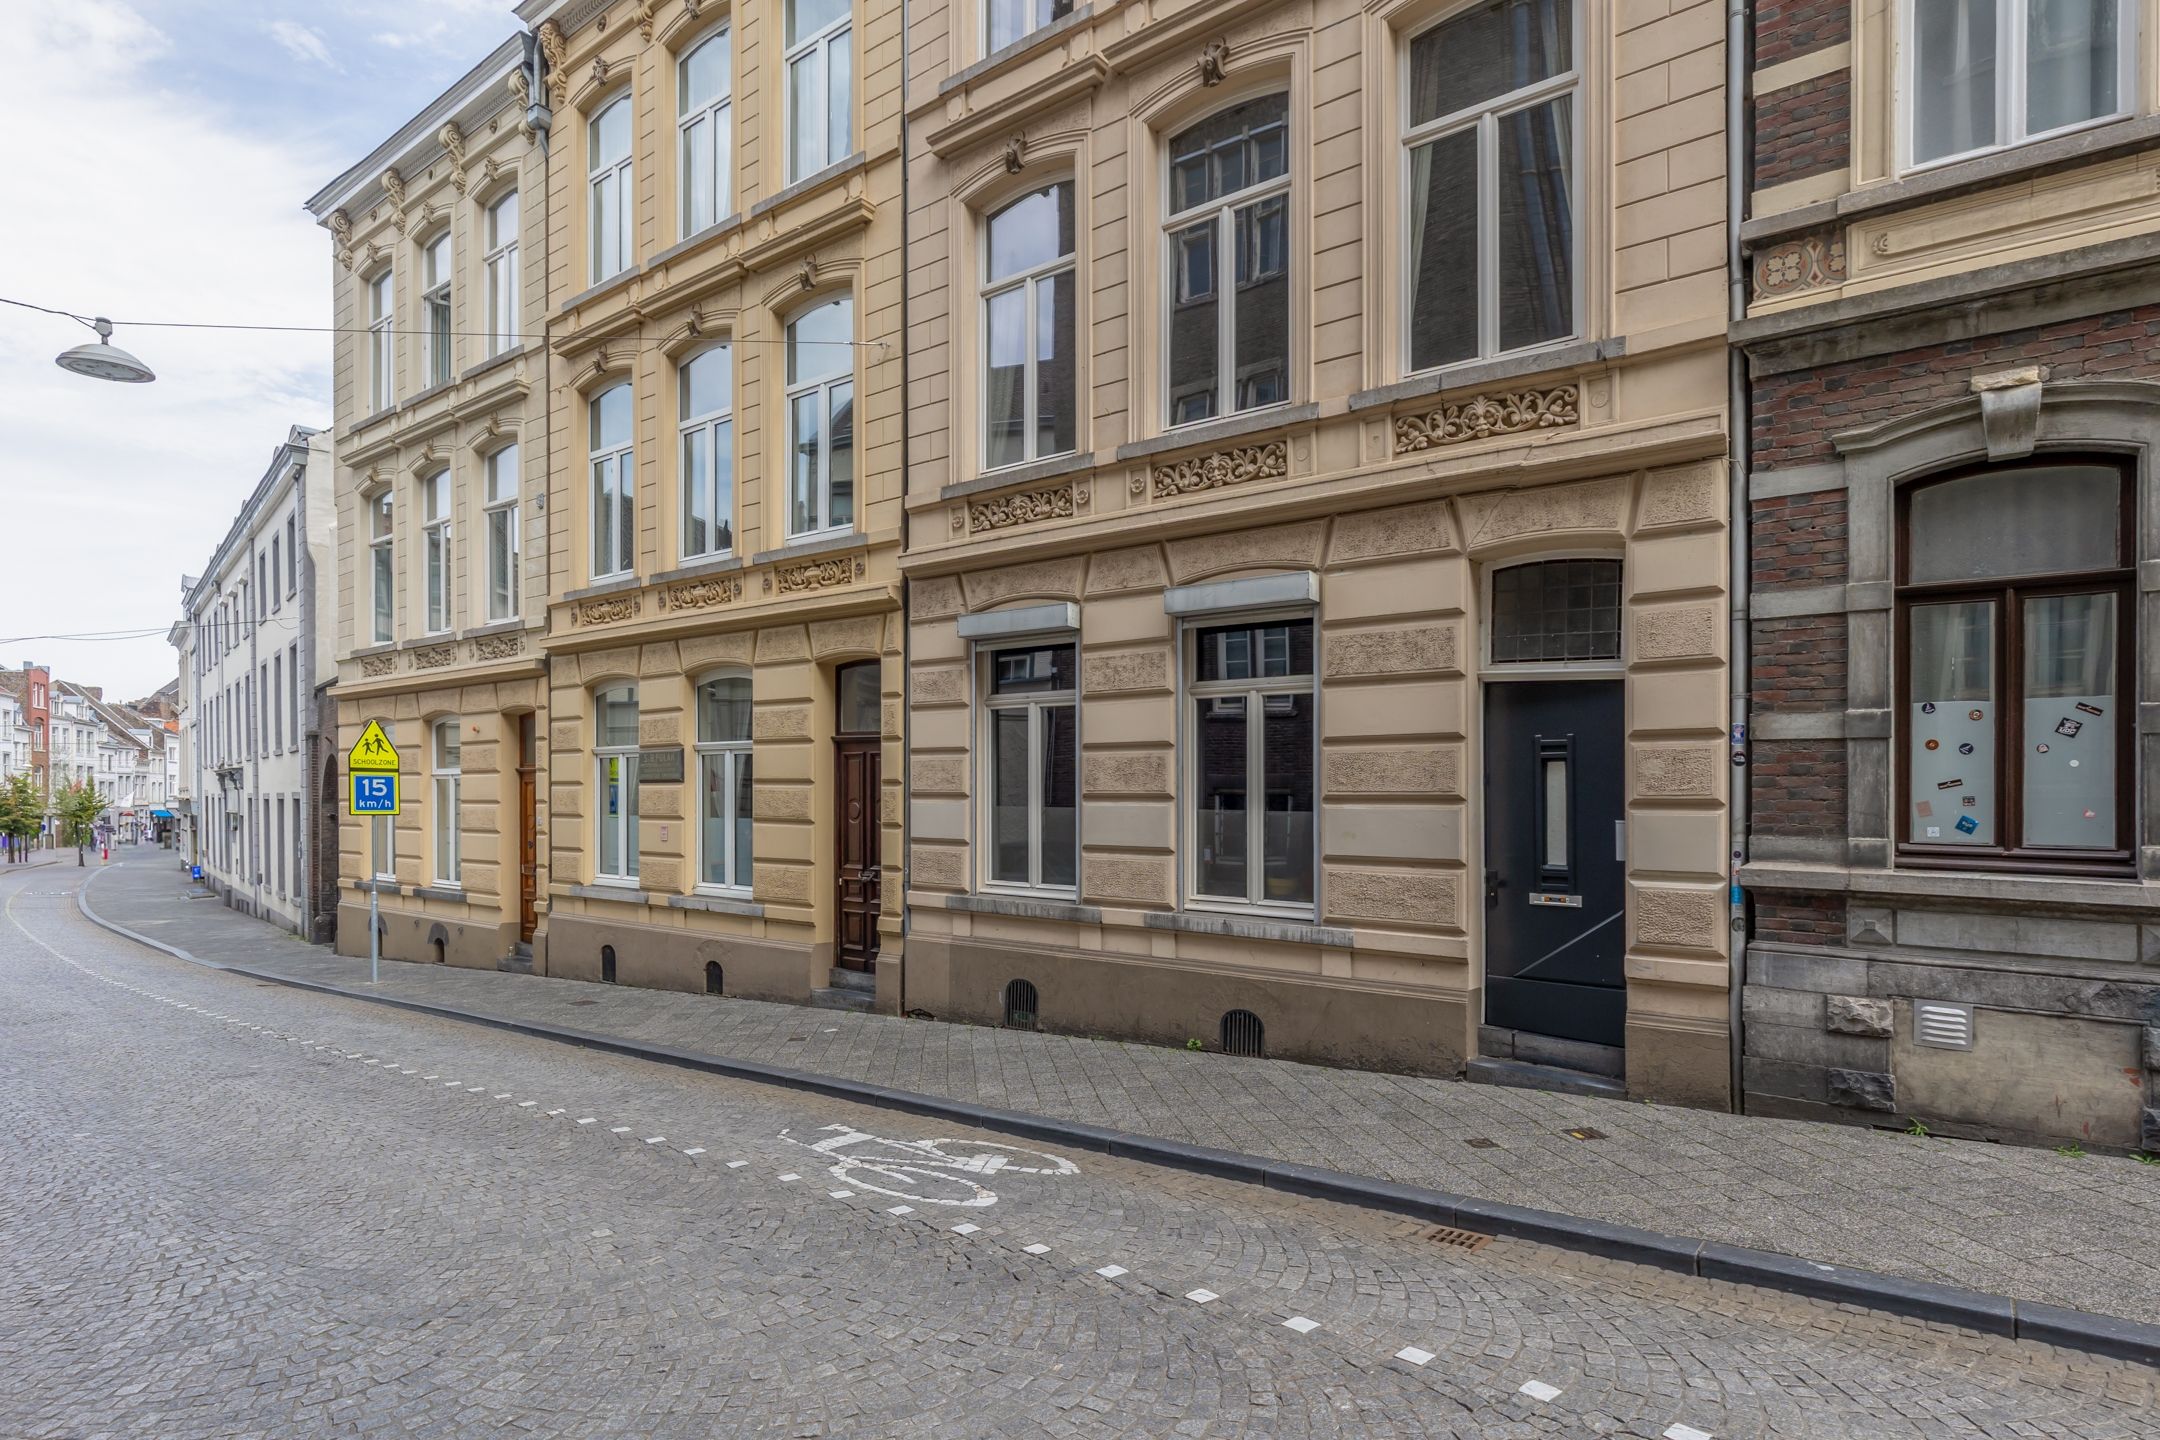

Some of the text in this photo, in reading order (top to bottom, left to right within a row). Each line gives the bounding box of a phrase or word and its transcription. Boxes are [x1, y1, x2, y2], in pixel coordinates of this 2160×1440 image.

[353, 758, 396, 766] SCHOOLZONE
[362, 778, 388, 797] 15
[359, 799, 392, 809] km/h
